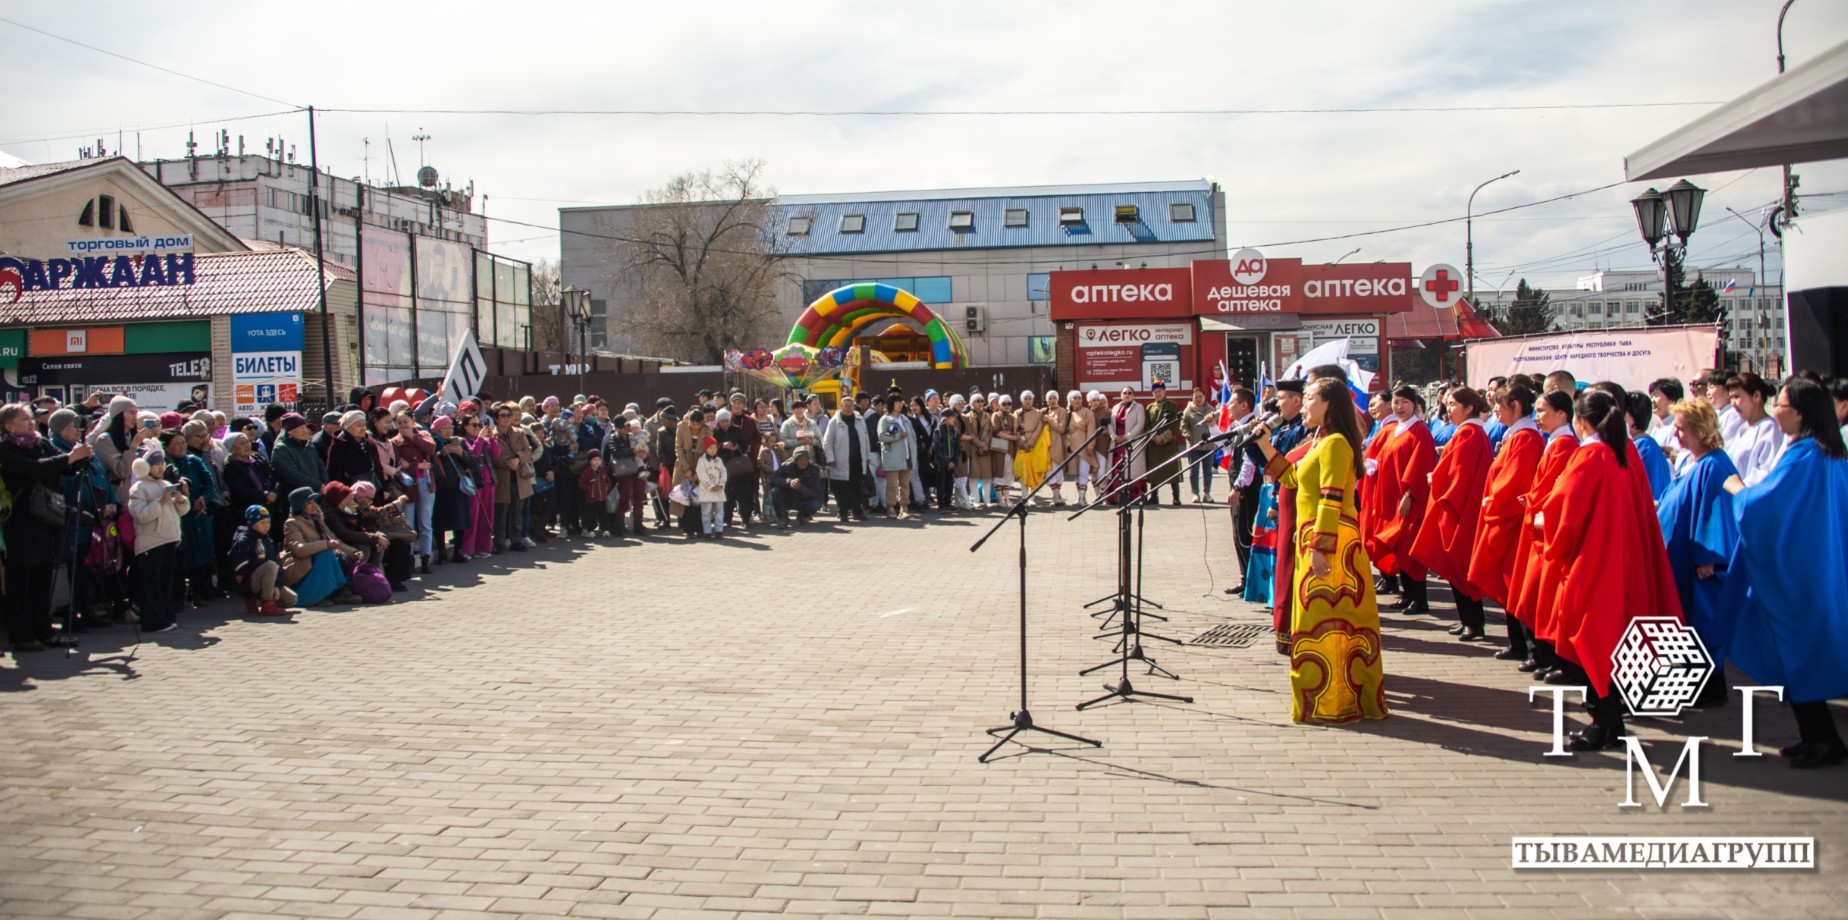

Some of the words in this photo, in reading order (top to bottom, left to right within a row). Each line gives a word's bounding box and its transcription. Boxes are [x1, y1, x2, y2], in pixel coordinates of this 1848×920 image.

[68, 237, 150, 252] торговый
[154, 237, 189, 249] дом
[1234, 258, 1264, 276] да
[1071, 283, 1173, 303] аптека
[1207, 285, 1291, 300] дешевая
[1303, 278, 1406, 298] аптека
[1217, 299, 1282, 312] аптека
[1335, 323, 1376, 335] ЛЕГКО
[42, 362, 62, 370] Салон
[236, 356, 296, 373] БИЛЕТЫ
